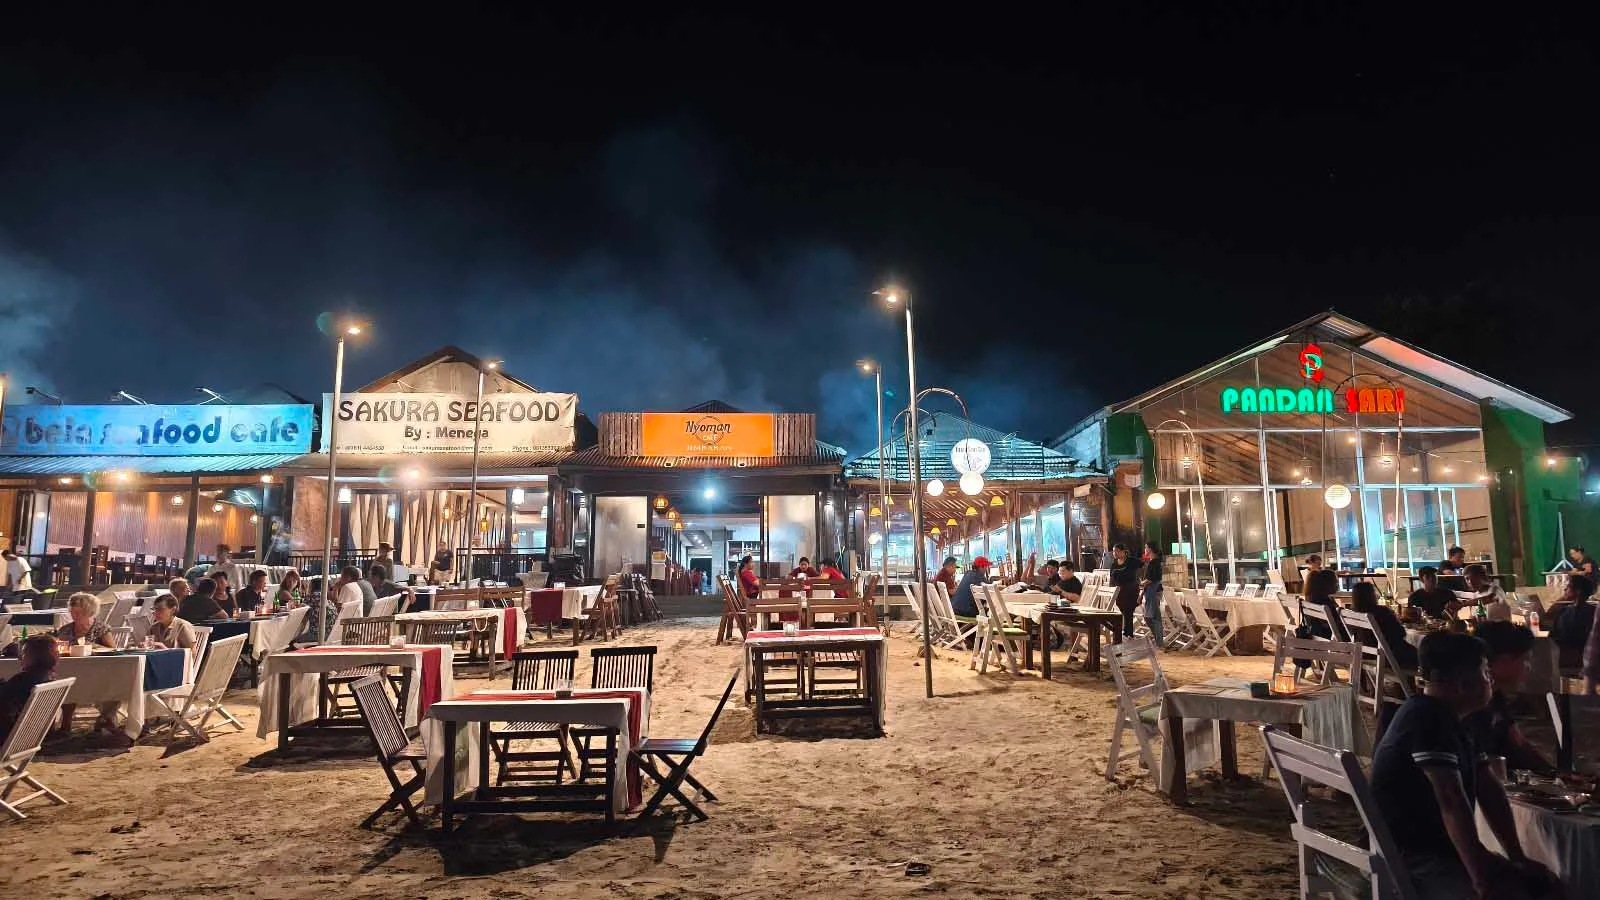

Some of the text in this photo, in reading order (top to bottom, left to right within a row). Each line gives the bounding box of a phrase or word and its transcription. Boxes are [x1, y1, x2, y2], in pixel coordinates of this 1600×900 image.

[338, 400, 560, 422] SAKURA SEAFOOD
[1221, 387, 1334, 414] PANDAN
[230, 416, 299, 443] cafe
[404, 426, 421, 441] By
[685, 420, 732, 435] Nyoman
